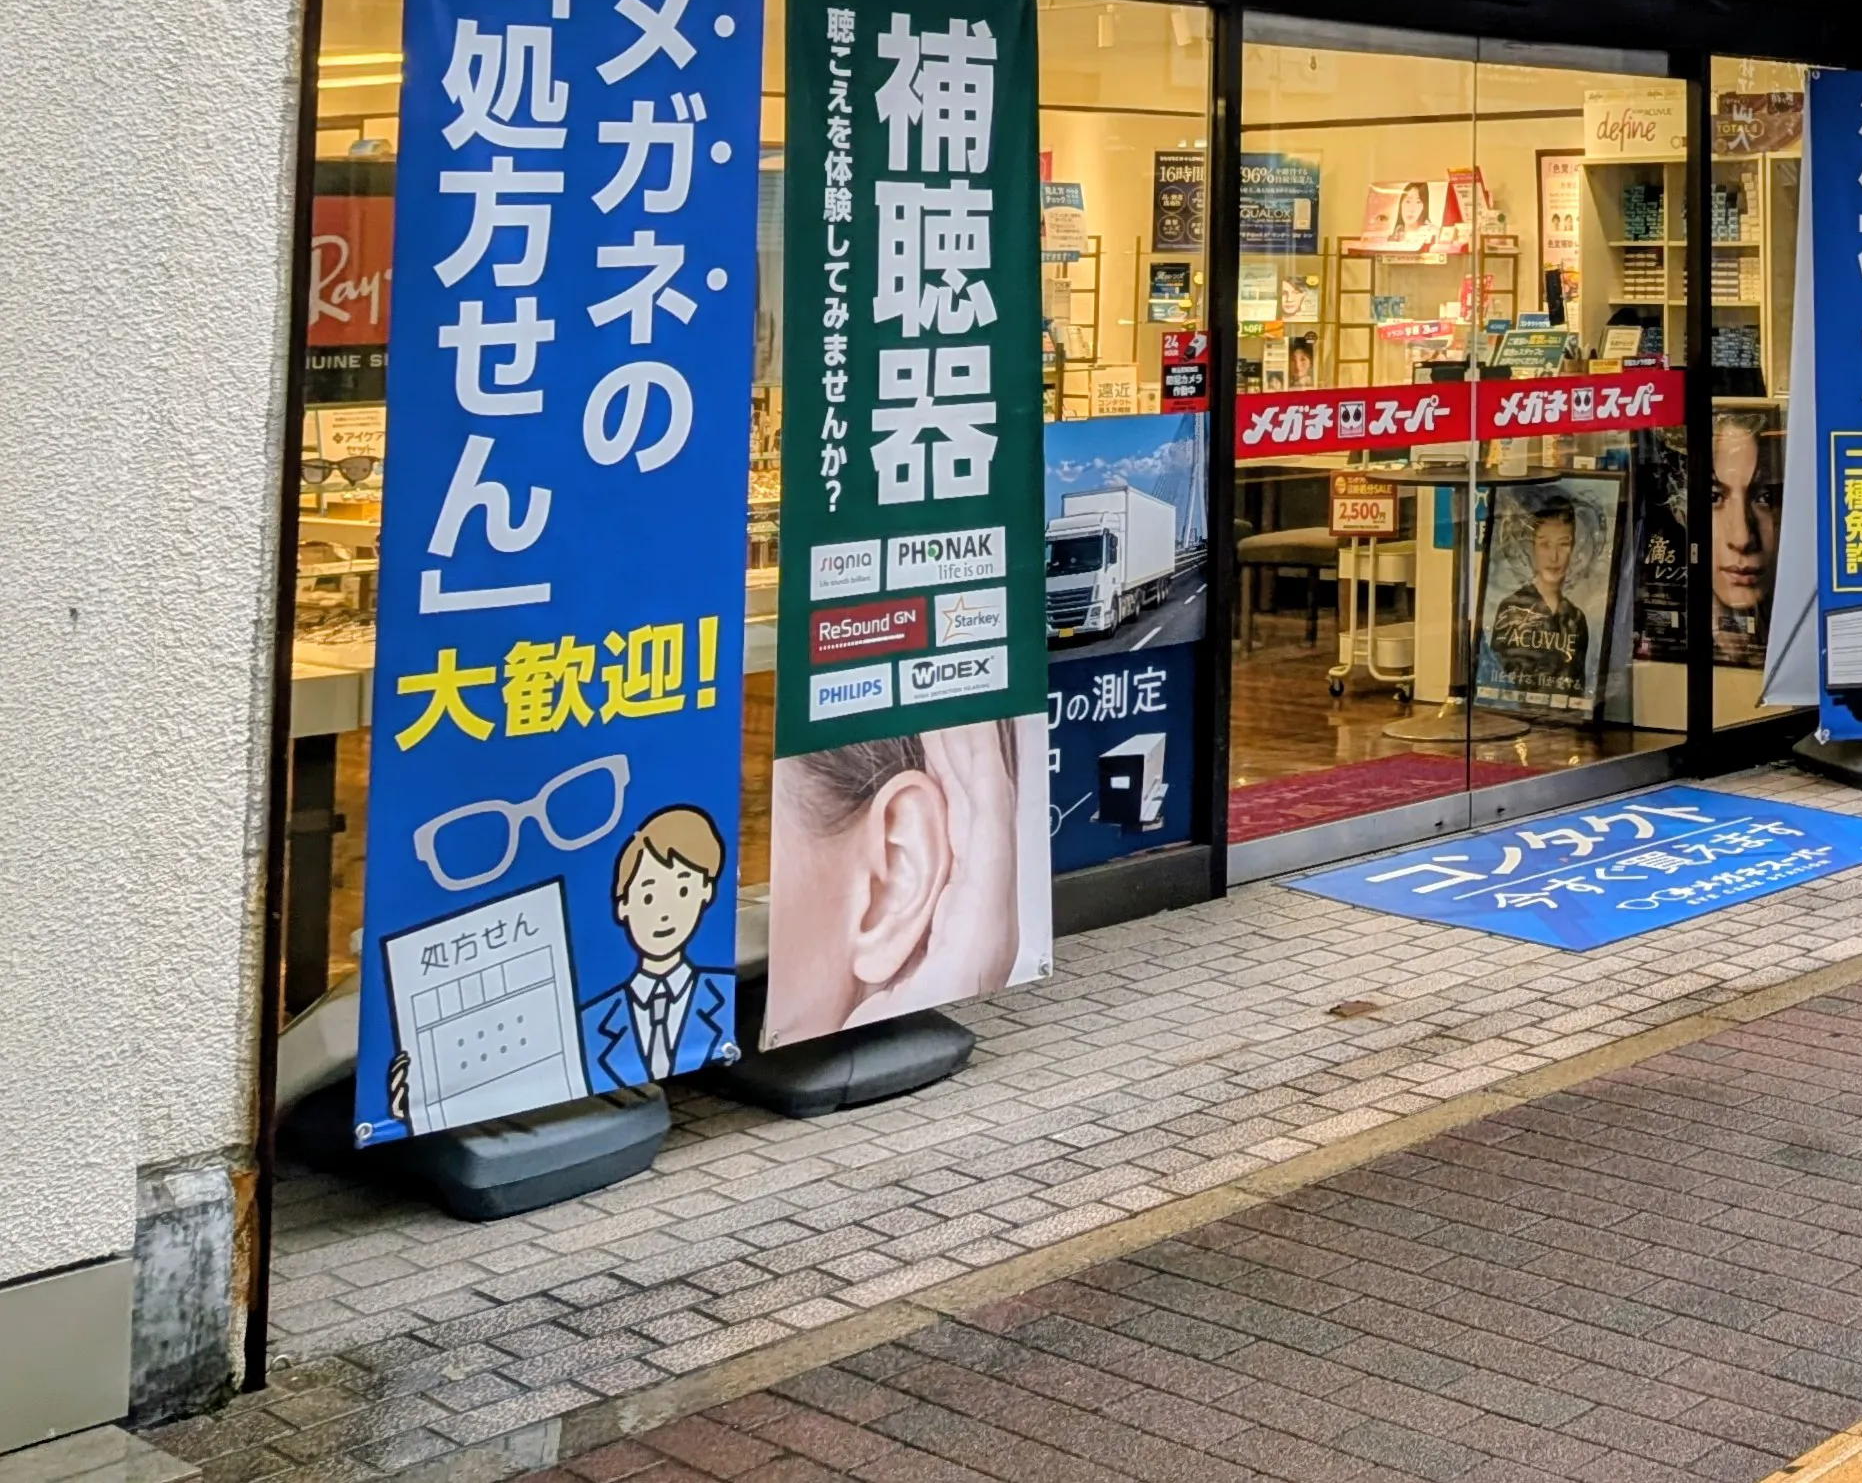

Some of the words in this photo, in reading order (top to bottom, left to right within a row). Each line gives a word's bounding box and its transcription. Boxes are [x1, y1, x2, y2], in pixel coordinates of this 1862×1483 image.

[1596, 108, 1657, 152] define
[821, 7, 857, 513] 聴こえを体験してみませんか?
[871, 13, 998, 505] 補聴器
[1164, 335, 1179, 348] 24
[306, 355, 361, 369] UINE
[820, 553, 872, 575] signia
[898, 533, 992, 566] PHONAK
[939, 564, 962, 580] life
[963, 564, 975, 577] is
[976, 563, 993, 576] on
[819, 613, 890, 641] ReSound
[894, 609, 916, 625] GN
[954, 612, 1000, 628] Starkey
[1508, 629, 1577, 652] ACUVUE
[393, 616, 719, 753] 大歓迎!
[912, 658, 991, 690] WIDEX
[819, 679, 882, 705] PHILIPS
[1365, 804, 1716, 894] コンタクト
[1494, 821, 1805, 909] 今すぐ買えます
[1692, 846, 1833, 891] メガネスーパー
[420, 912, 540, 976] 処方せん
